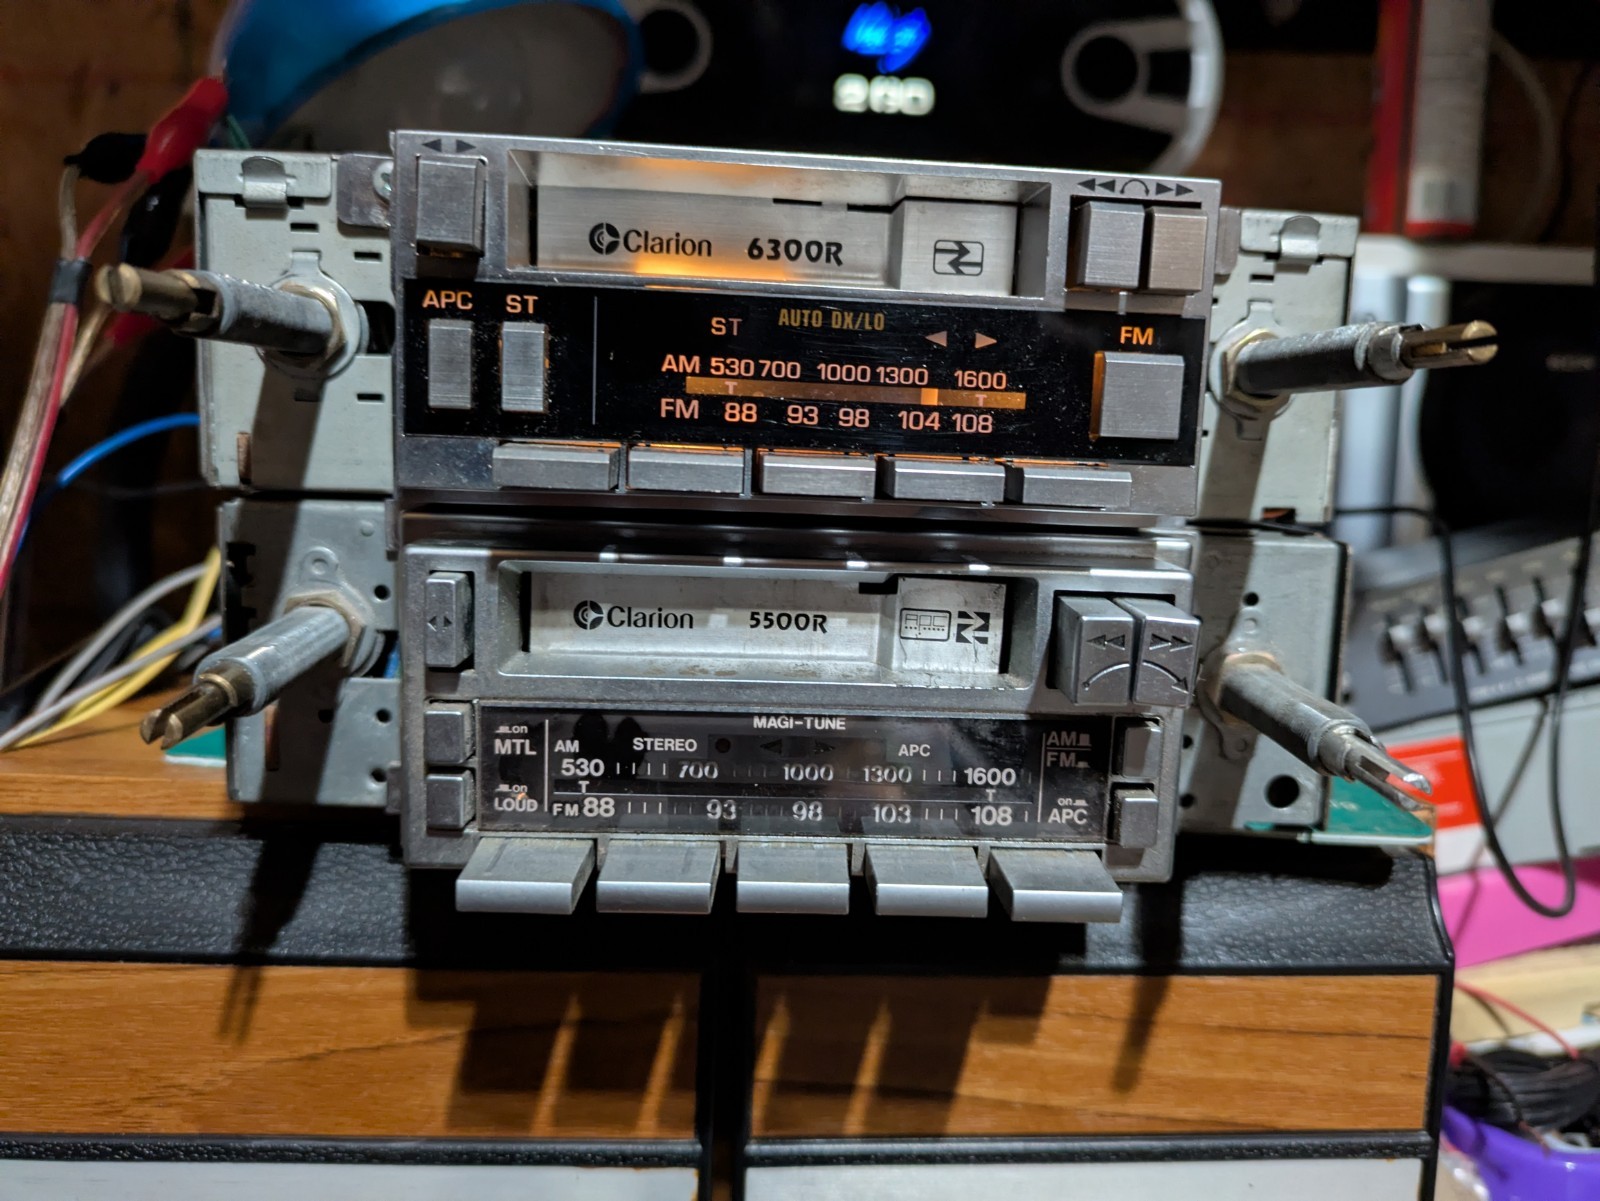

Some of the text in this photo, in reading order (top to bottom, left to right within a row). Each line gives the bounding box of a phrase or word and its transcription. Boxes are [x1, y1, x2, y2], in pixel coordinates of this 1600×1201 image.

[623, 229, 843, 267] Clarion 6300R
[422, 289, 474, 311] APC
[505, 294, 539, 314] ST
[711, 316, 743, 336] ST
[778, 308, 885, 331] AUTO DX/LO
[1119, 326, 1155, 346] FM
[660, 354, 1007, 390] AM 530 700 1000 1300 1600
[660, 398, 993, 433] FM 88 93 98 104 108
[607, 605, 828, 634] Clarion 5500R
[511, 725, 529, 734] on
[753, 716, 846, 731] MAGI-TUNE
[494, 738, 537, 756] MTL
[554, 739, 580, 753] AM
[632, 737, 698, 752] STEREO
[1046, 731, 1077, 747] AM
[898, 744, 931, 758] APC
[1046, 751, 1077, 768] FM
[561, 758, 1017, 786] 530 700 1000 1300 1600
[511, 784, 529, 793] on
[494, 798, 539, 813] LOUD
[1057, 797, 1073, 807] on
[552, 797, 1013, 826] FM 88 93 98 103 108
[1048, 808, 1088, 825] APC
